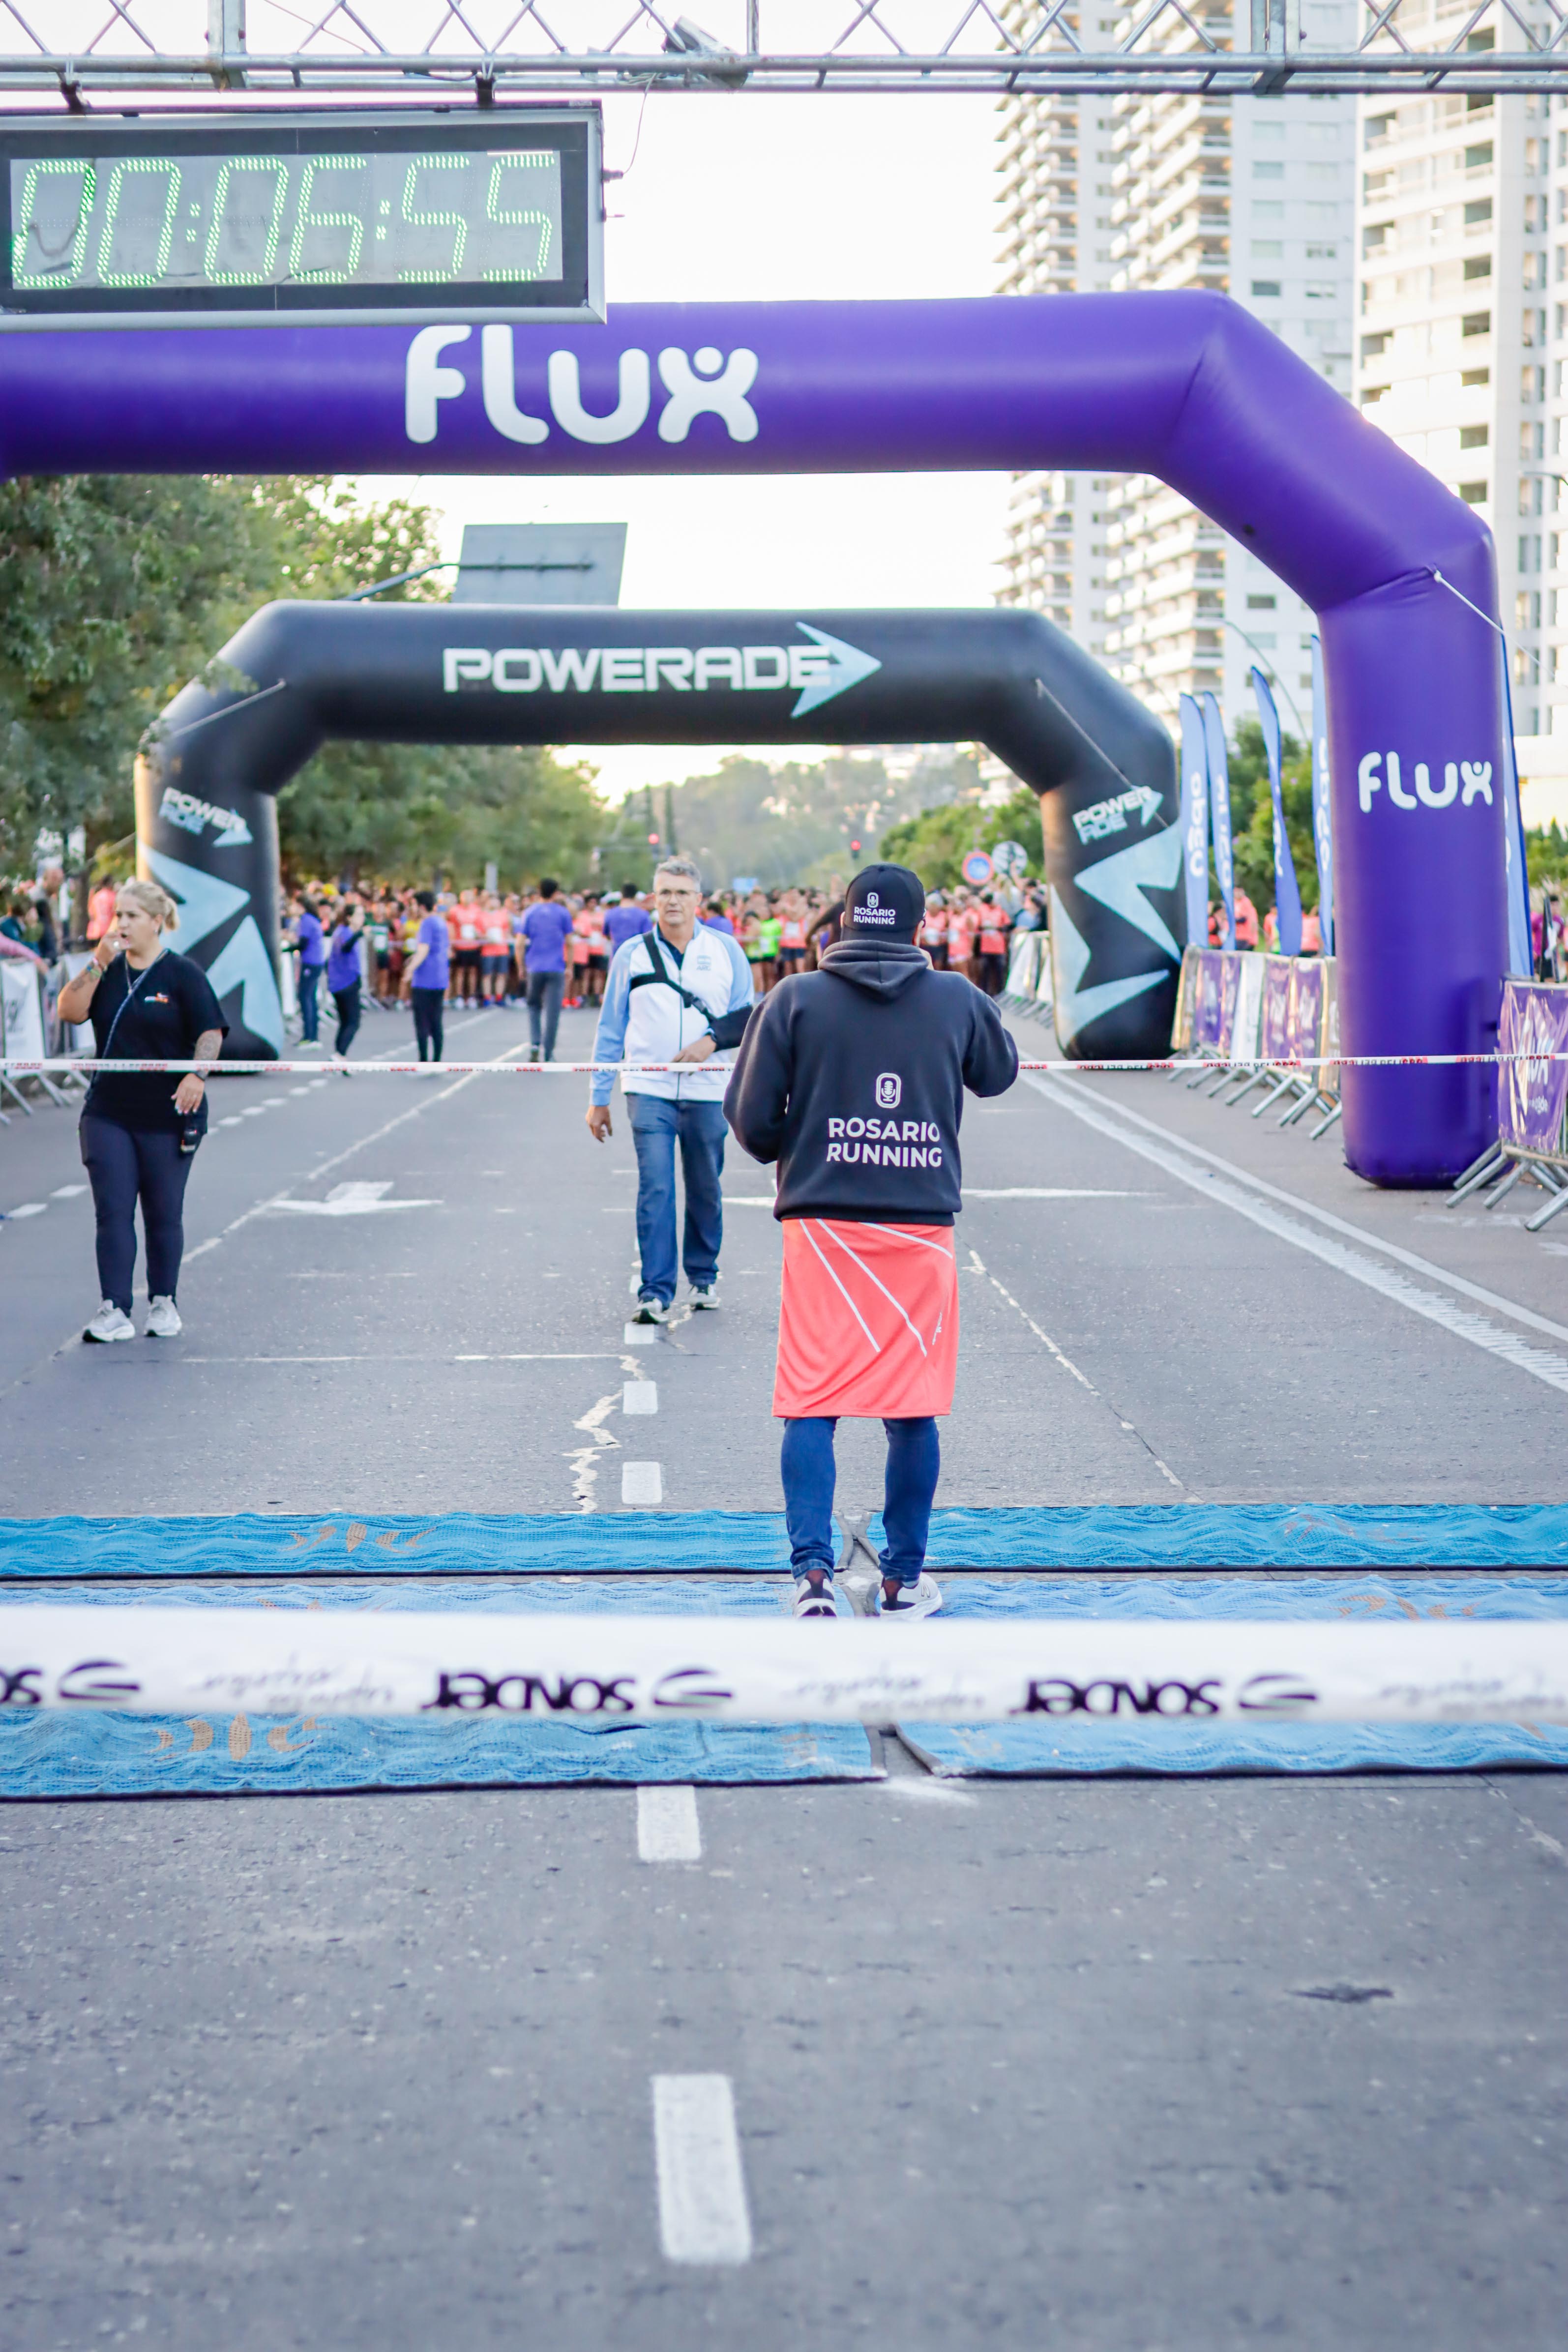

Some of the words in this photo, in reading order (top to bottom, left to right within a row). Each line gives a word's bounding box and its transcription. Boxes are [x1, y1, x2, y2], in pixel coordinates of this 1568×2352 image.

[11, 154, 556, 288] 00:06:55
[443, 645, 832, 693] POWERADE
[163, 787, 246, 832] POWER
[1072, 785, 1153, 829] POWER
[853, 914, 895, 925] RUNNING
[854, 906, 895, 917] ROSARIO
[828, 1117, 940, 1142] ROSARIO
[826, 1143, 942, 1167] RUNNING
